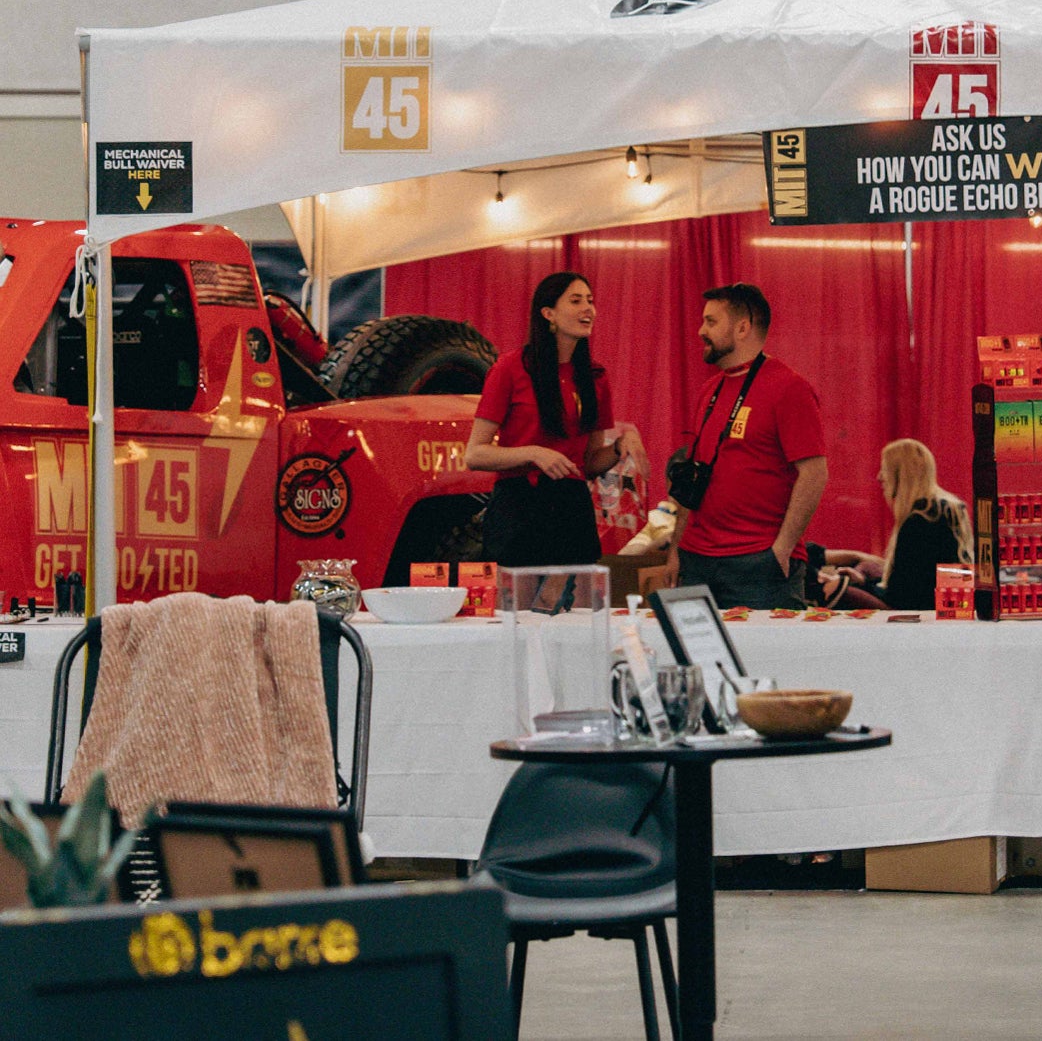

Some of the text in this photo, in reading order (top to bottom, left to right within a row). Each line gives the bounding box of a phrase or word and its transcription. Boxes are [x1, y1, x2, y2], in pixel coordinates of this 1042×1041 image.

[352, 76, 421, 140] 45
[921, 73, 990, 120] 45
[932, 123, 1006, 152] ASK US
[104, 149, 185, 160] MECHANICAL
[104, 159, 185, 170] BULL WAIVER
[857, 157, 905, 184] HOW
[911, 155, 952, 183] YOU
[957, 153, 1000, 182] CAN
[128, 170, 161, 180] HERE
[773, 134, 808, 216] MIT 45
[869, 188, 884, 214] A
[889, 185, 957, 213] ROGUE
[963, 182, 1018, 210] ECHO
[732, 421, 744, 435] 45
[144, 459, 191, 525] 45
[294, 488, 342, 510] SIGNS
[34, 543, 83, 590] GET
[0, 633, 18, 642] AL
